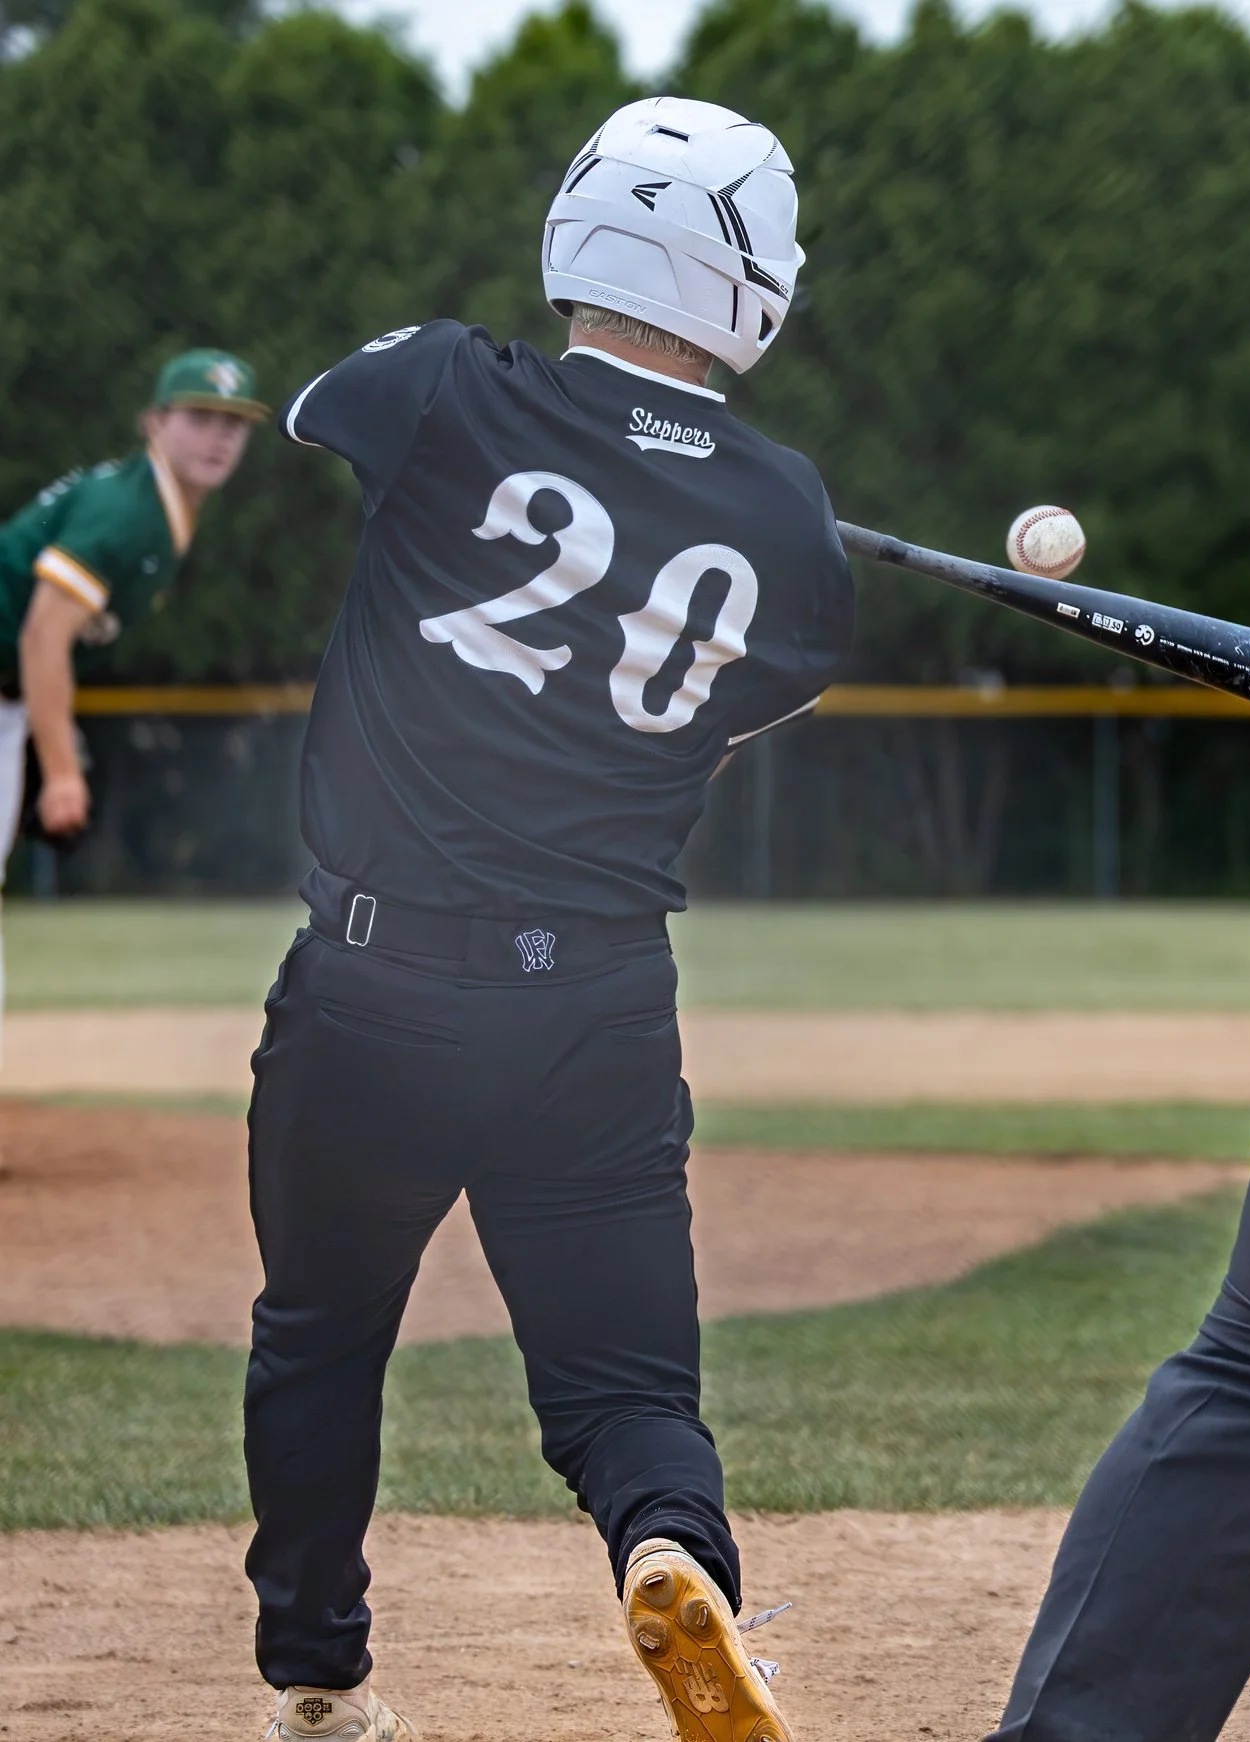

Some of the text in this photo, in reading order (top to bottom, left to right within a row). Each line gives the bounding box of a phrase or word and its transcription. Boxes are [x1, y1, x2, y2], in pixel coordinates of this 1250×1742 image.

[589, 289, 647, 313] EASTON
[627, 407, 715, 448] Stoppers
[419, 471, 759, 733] 20
